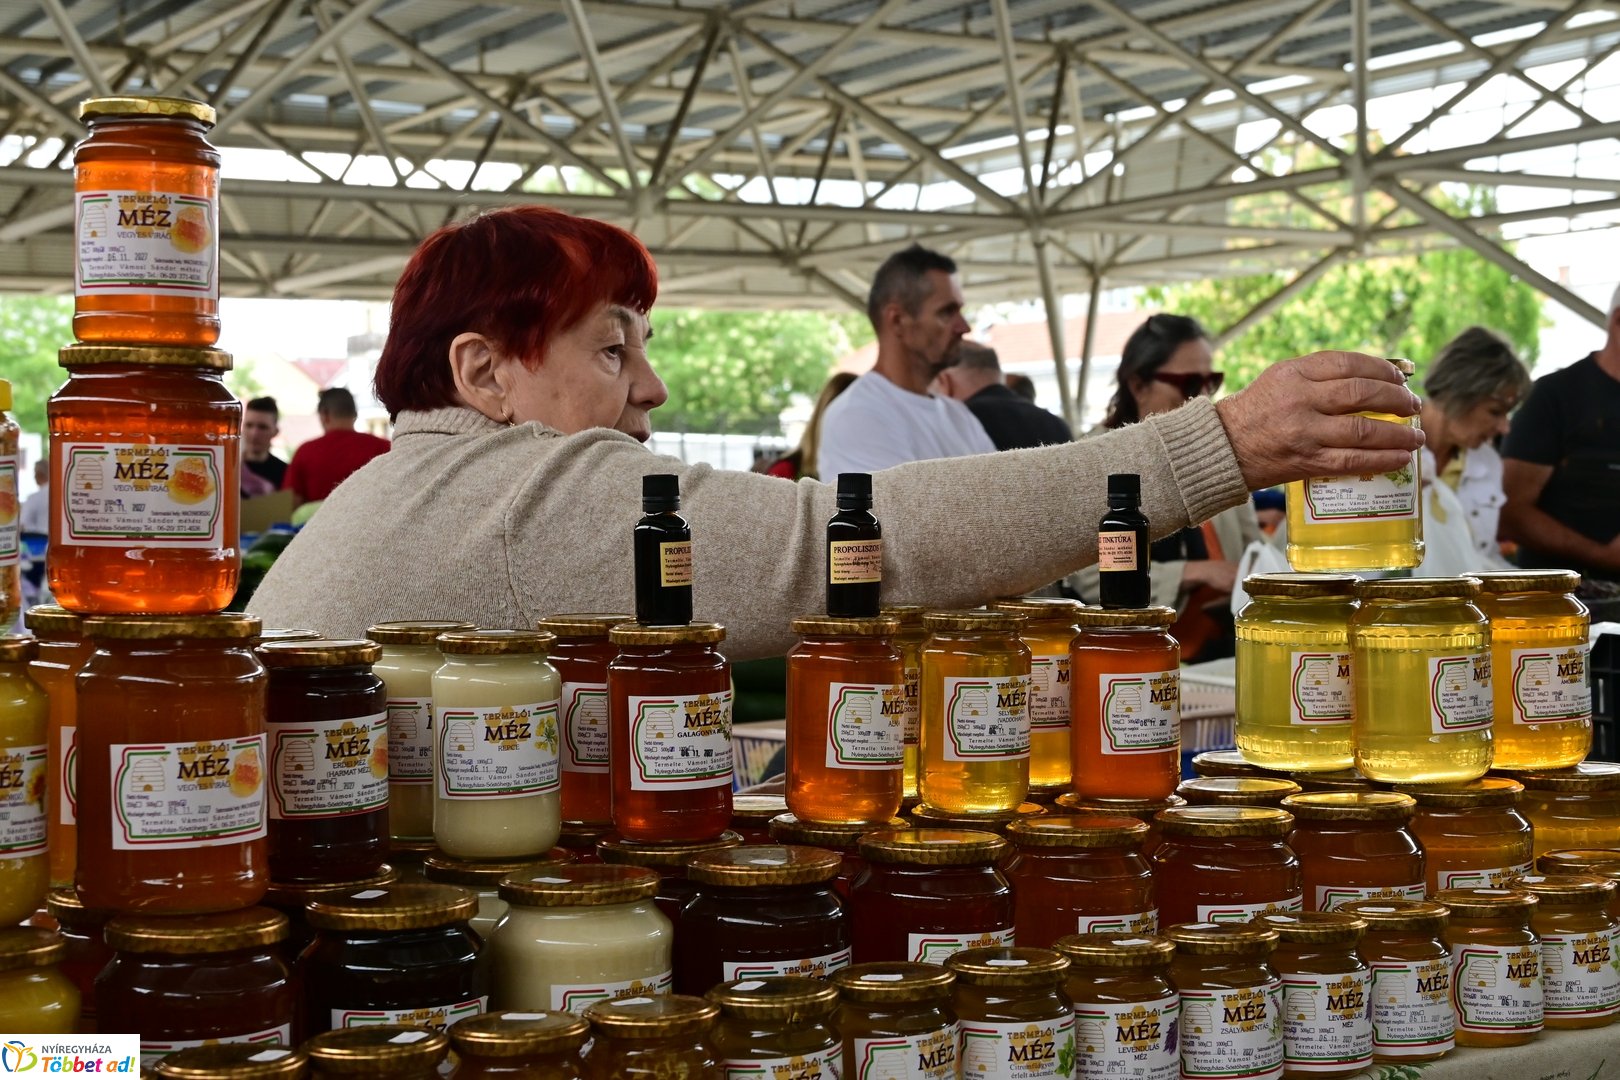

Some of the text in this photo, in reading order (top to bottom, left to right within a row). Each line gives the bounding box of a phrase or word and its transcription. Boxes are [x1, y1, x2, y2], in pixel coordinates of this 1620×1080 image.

[117, 194, 172, 204] TERMELŐI
[117, 205, 172, 227] MÉZ
[114, 447, 170, 457] TERMELŐI
[114, 458, 170, 480] MÉZ
[1103, 535, 1132, 543] TINKTÚRA
[1557, 660, 1584, 677] MÉZ
[996, 689, 1026, 708] MÉZ
[1150, 684, 1178, 703] MÉZ
[683, 696, 722, 708] TERMELŐI
[483, 709, 531, 720] TERMELŐI
[684, 707, 722, 728] MÉZ
[324, 724, 370, 738] TERMELŐI
[484, 720, 532, 742] MÉZ
[176, 742, 230, 756] TERMELŐI
[325, 736, 370, 760] MÉZ
[498, 744, 520, 752] REPCE
[177, 755, 230, 780] MÉZ
[1367, 889, 1405, 898] TERMELŐI
[966, 936, 1003, 948] TERMELŐI
[1571, 934, 1610, 946] TERMELŐI
[1572, 945, 1611, 965] MÉZ
[783, 960, 826, 975] TERMELŐI
[1506, 960, 1539, 979] MÉZ
[614, 982, 656, 998] TERMELŐI
[1326, 979, 1364, 990] TERMELŐI
[1416, 972, 1449, 994] MÉZ
[1221, 989, 1266, 1002] TERMELŐI
[1326, 990, 1364, 1011] MÉZ
[395, 1008, 448, 1022] TERMELŐI
[1114, 1008, 1161, 1020] TERMELŐI
[1222, 1000, 1267, 1023] MÉZ
[1007, 1027, 1056, 1040] TERMELŐI
[1116, 1020, 1161, 1042] MÉZ
[1008, 1039, 1056, 1062] MÉZ
[1118, 1044, 1160, 1054] LEVENDULÁS
[771, 1057, 822, 1074] TERMELŐI
[918, 1044, 955, 1071] MÉZ
